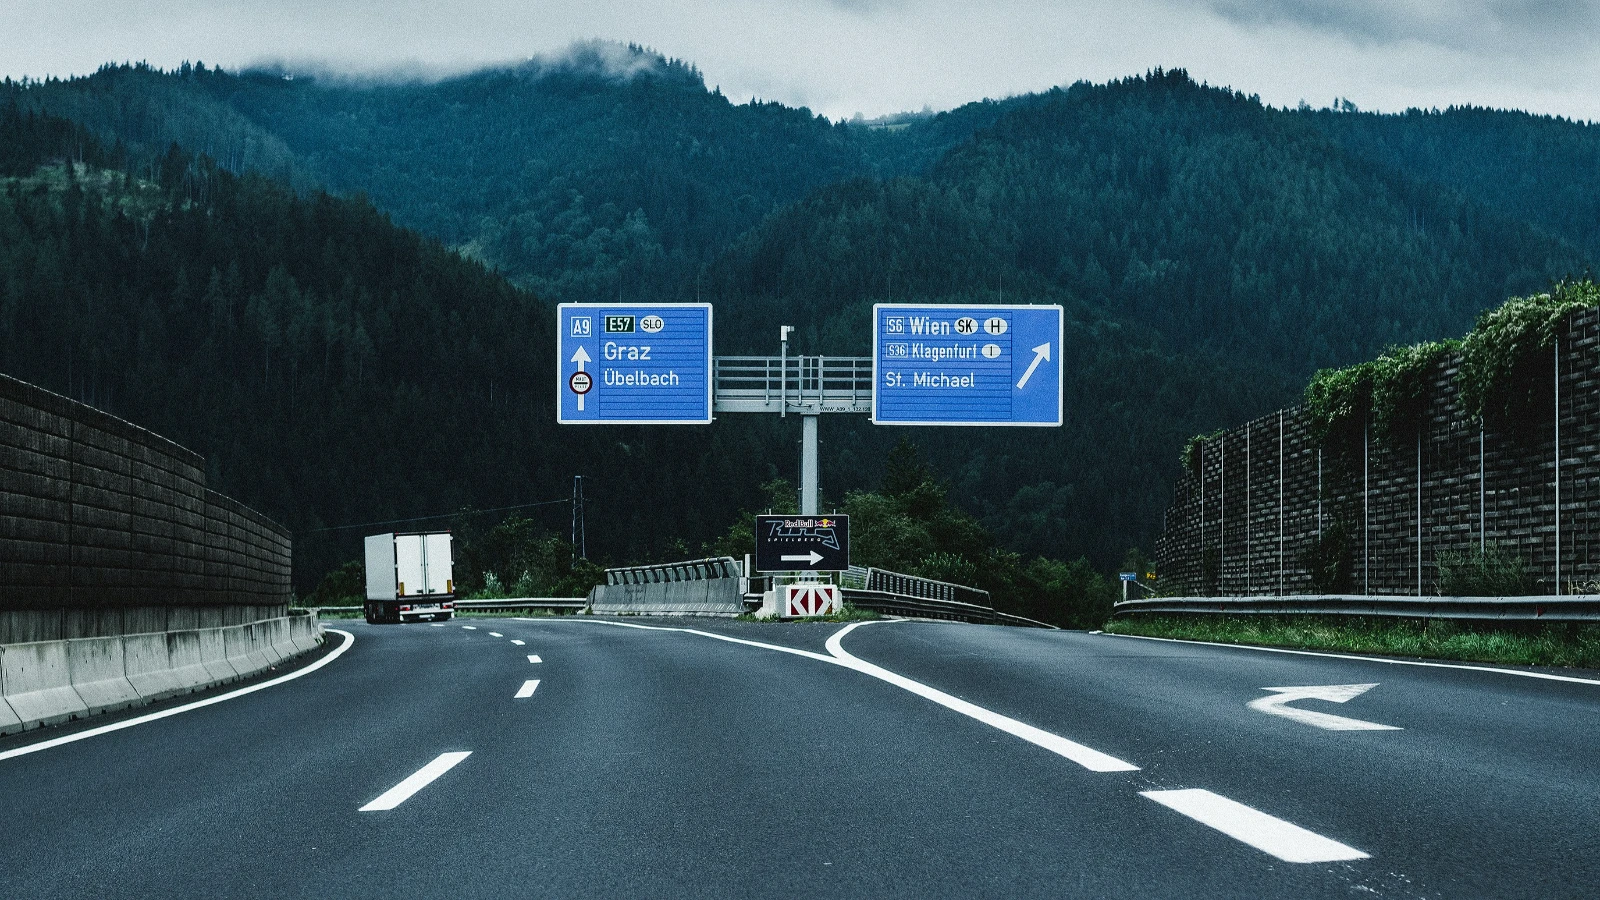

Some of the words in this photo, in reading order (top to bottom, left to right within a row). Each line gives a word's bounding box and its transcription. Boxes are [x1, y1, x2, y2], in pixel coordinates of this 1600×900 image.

[573, 319, 590, 335] A9
[609, 317, 631, 331] E57
[643, 319, 662, 330] SLO
[888, 319, 903, 333] S6
[909, 316, 950, 335] Wien
[958, 319, 973, 333] SK
[991, 319, 1000, 333] H
[604, 341, 651, 360] Graz
[889, 345, 905, 356] S36
[912, 343, 977, 362] Klagenfurt
[604, 368, 679, 386] Übelbach
[885, 371, 906, 387] St.
[913, 372, 975, 388] Michael
[784, 520, 799, 528] Red
[800, 520, 813, 528] Bull
